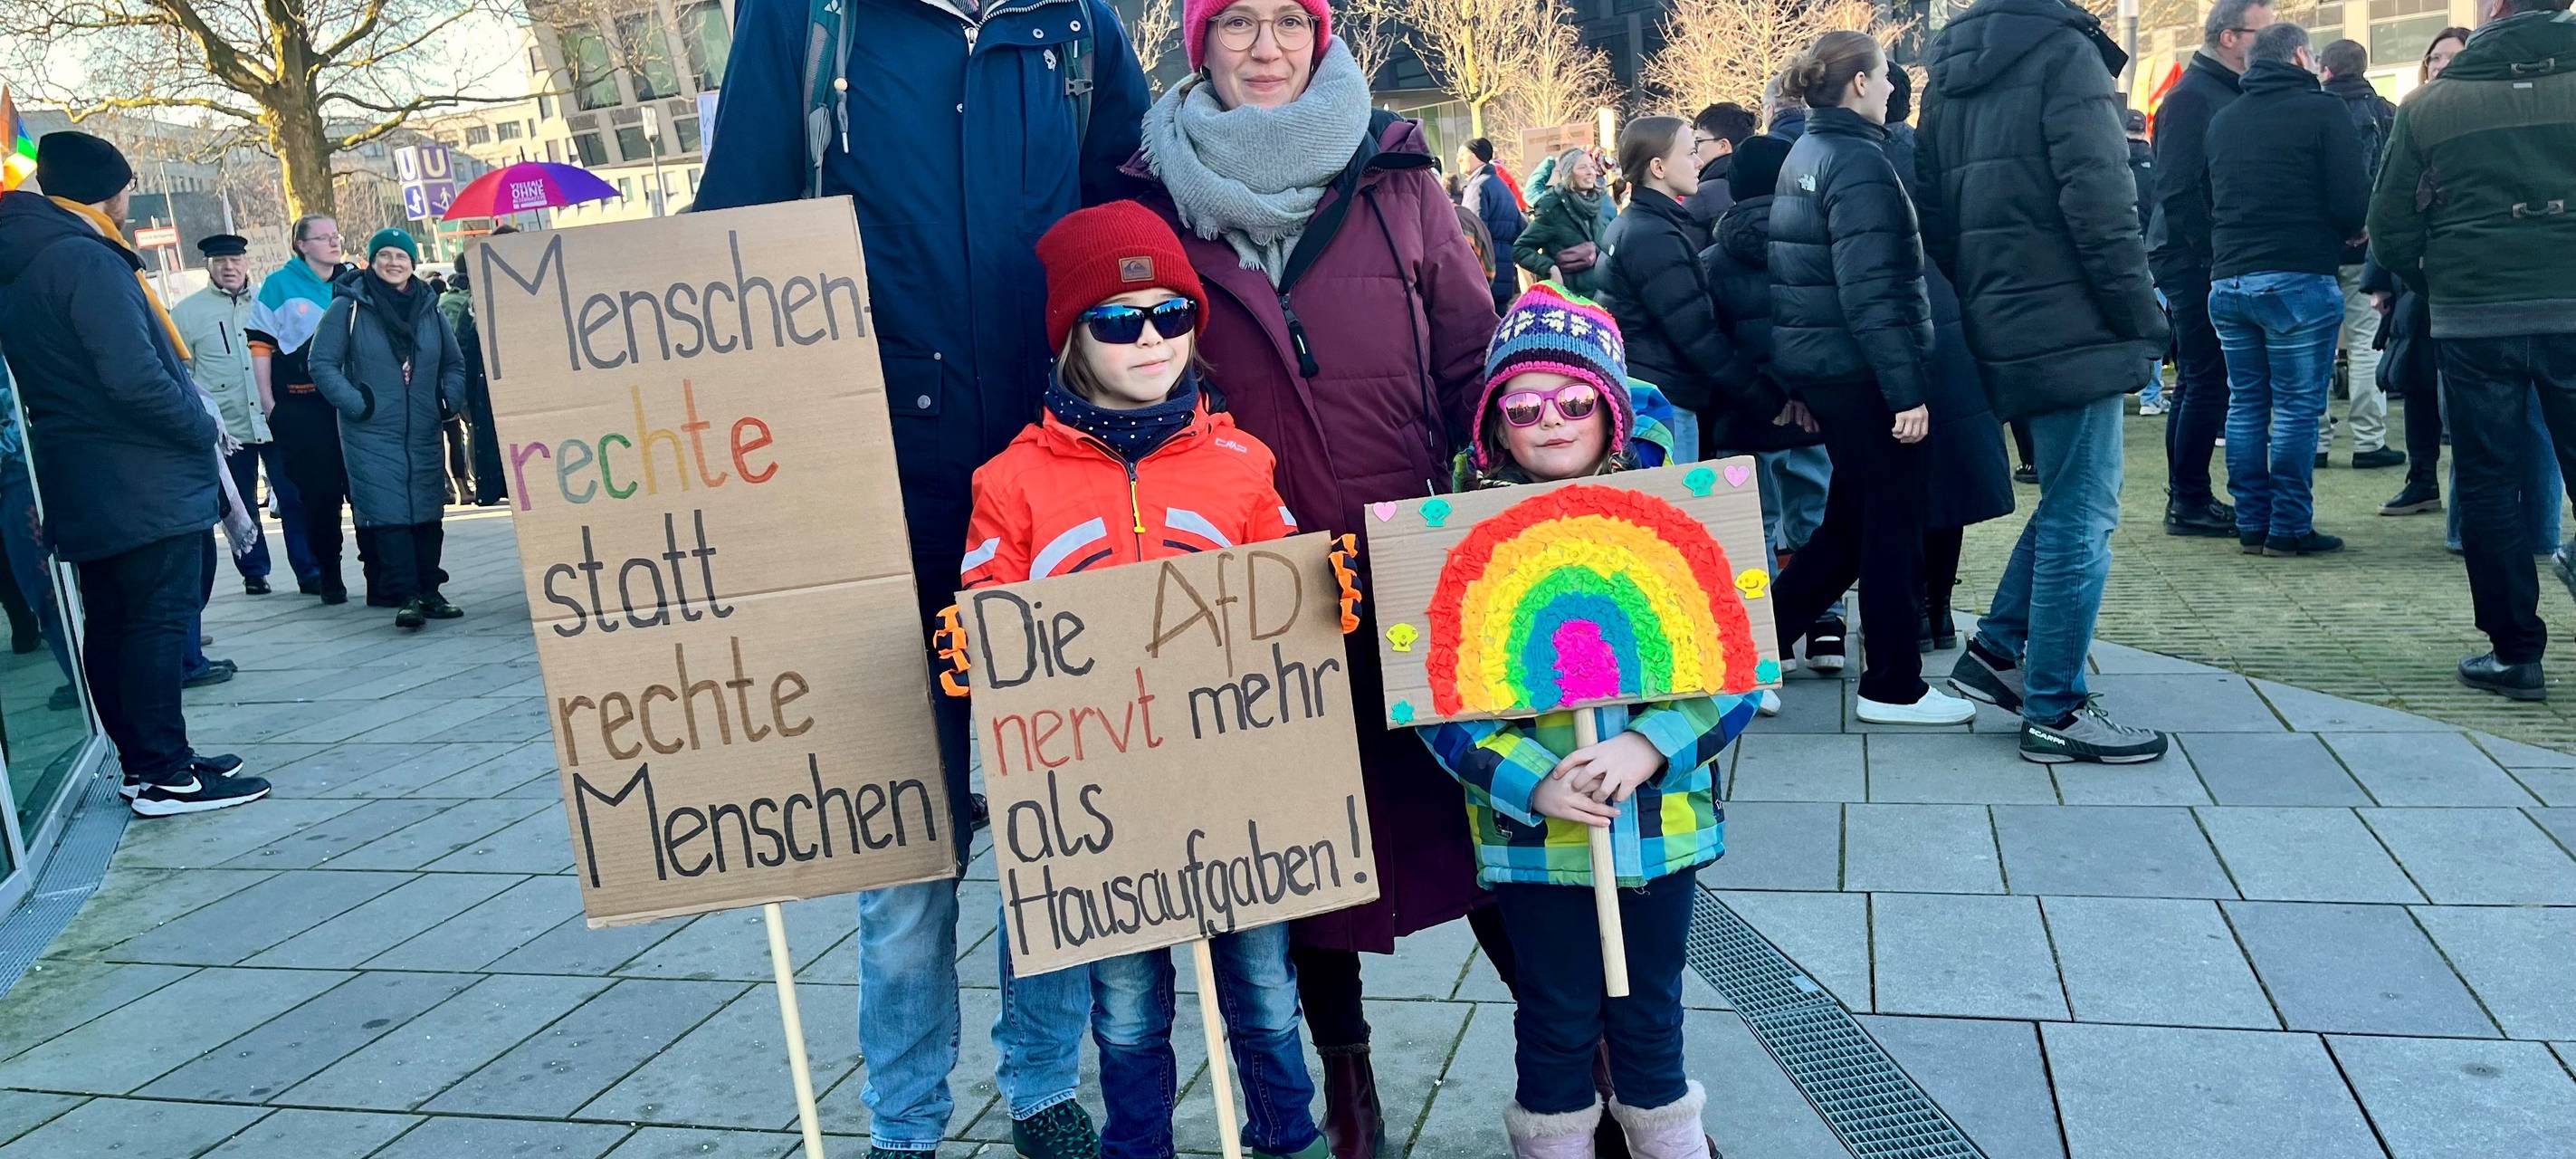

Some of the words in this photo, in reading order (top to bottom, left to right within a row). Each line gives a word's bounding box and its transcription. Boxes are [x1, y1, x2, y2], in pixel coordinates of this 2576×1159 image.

[397, 150, 416, 181] U
[422, 148, 446, 178] U
[511, 186, 544, 199] OHNE
[480, 230, 871, 381] Menschen-
[509, 378, 779, 512] rechte
[544, 509, 735, 637] statt
[973, 590, 1095, 689] Die
[1145, 551, 1302, 677] AfD
[558, 637, 815, 767] rechte
[992, 666, 1163, 777] nervt
[1188, 643, 1340, 740] mehr
[2028, 727, 2066, 746] SCARPA
[573, 752, 937, 888] Menschen
[1007, 771, 1114, 863] als
